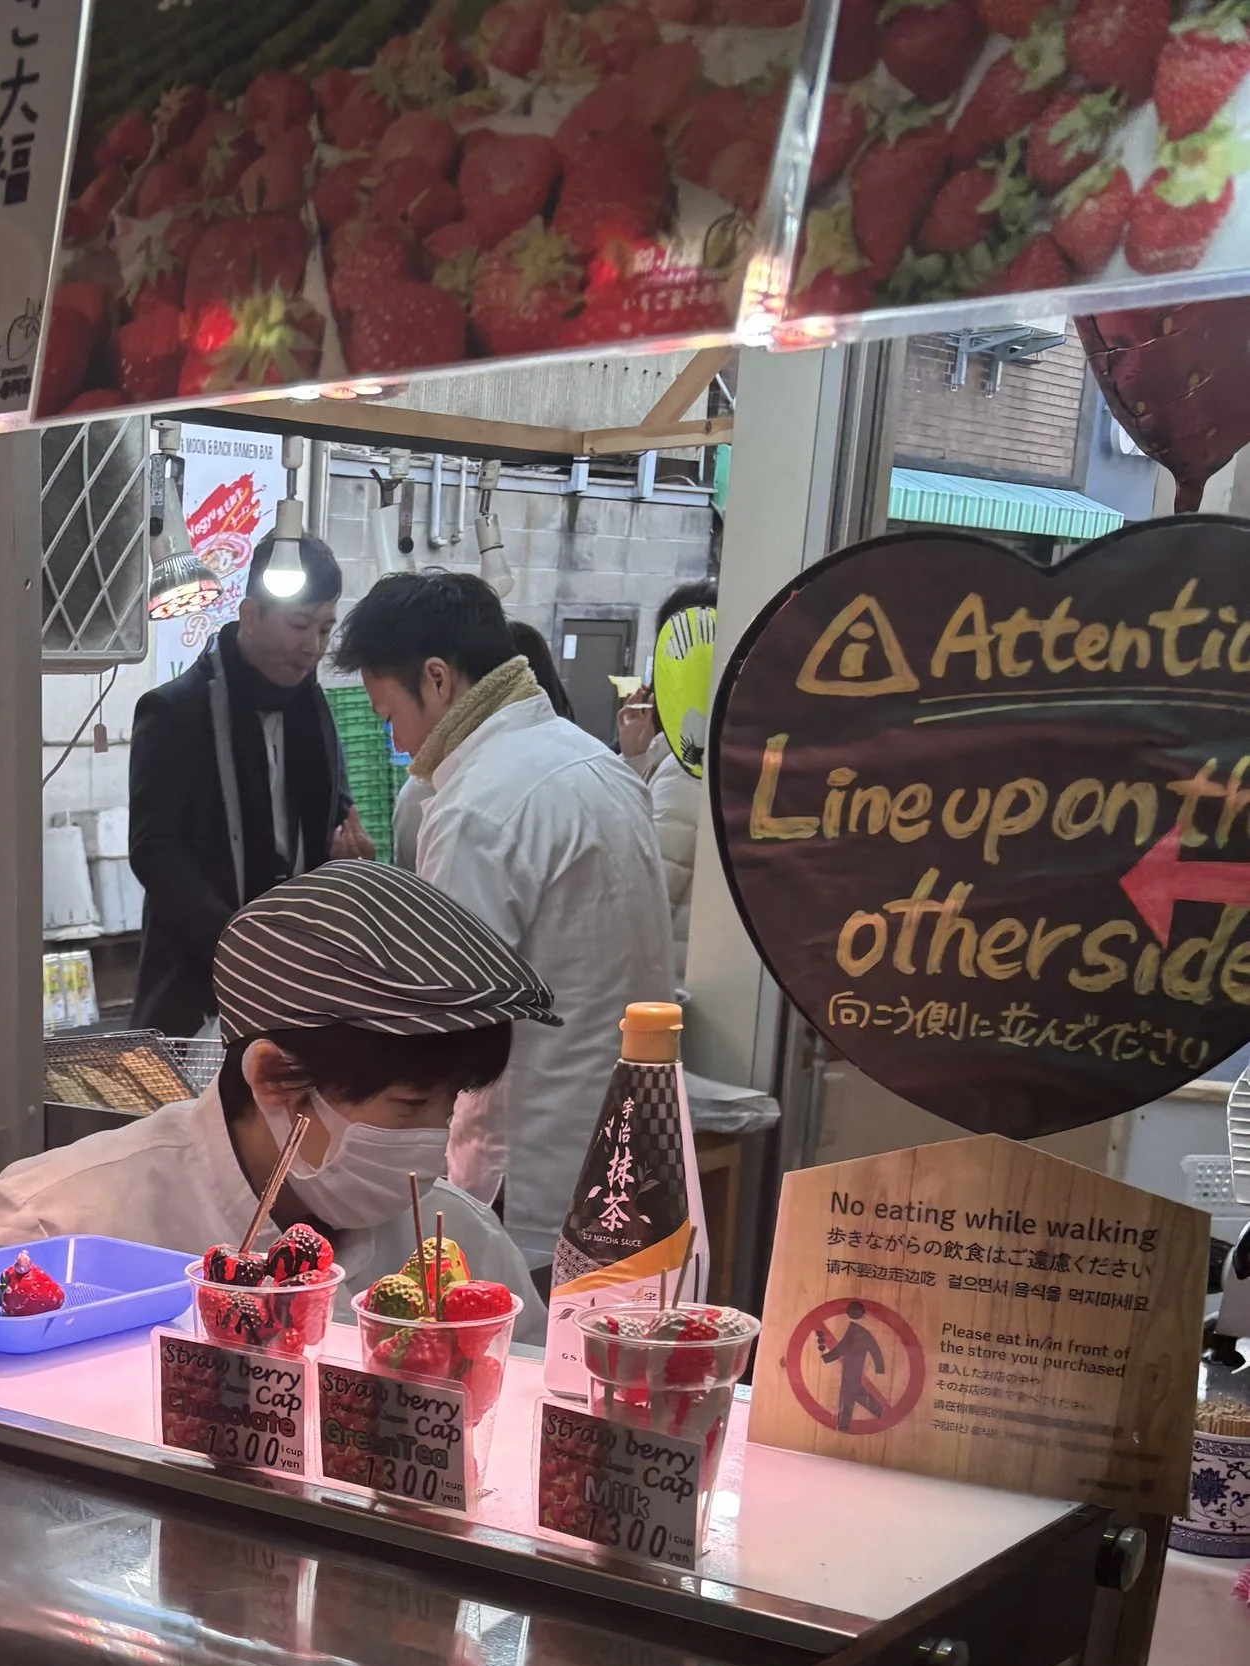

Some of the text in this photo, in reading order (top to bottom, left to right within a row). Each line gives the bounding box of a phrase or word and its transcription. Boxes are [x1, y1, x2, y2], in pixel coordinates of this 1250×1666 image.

[750, 733, 931, 843] Line
[942, 777, 1049, 865] up
[1052, 777, 1157, 847] on
[836, 866, 1250, 1005] other side
[827, 991, 1210, 1070] 向こう側に並んでください
[594, 1234, 643, 1248] MATCHA SAUCE
[830, 1191, 1160, 1252] No eating while walking
[826, 1227, 1152, 1280] 歩きながらの飲食はご遠慮ください
[948, 1274, 1009, 1297] 걸으면서
[940, 1340, 1127, 1379] the store you purchased
[941, 1322, 991, 1342] Please
[996, 1333, 1020, 1347] eat
[1068, 1338, 1108, 1357] front
[1114, 1345, 1132, 1361] of
[255, 1385, 302, 1418] Cap
[208, 1425, 279, 1467] 1300
[414, 1416, 462, 1450] Cap
[280, 1458, 300, 1469] yen
[366, 1455, 438, 1501] 1300
[440, 1493, 461, 1504] yen
[583, 1473, 651, 1520] Milk
[642, 1466, 694, 1504] Cap
[586, 1506, 667, 1559] 1300
[667, 1550, 690, 1563] yen
